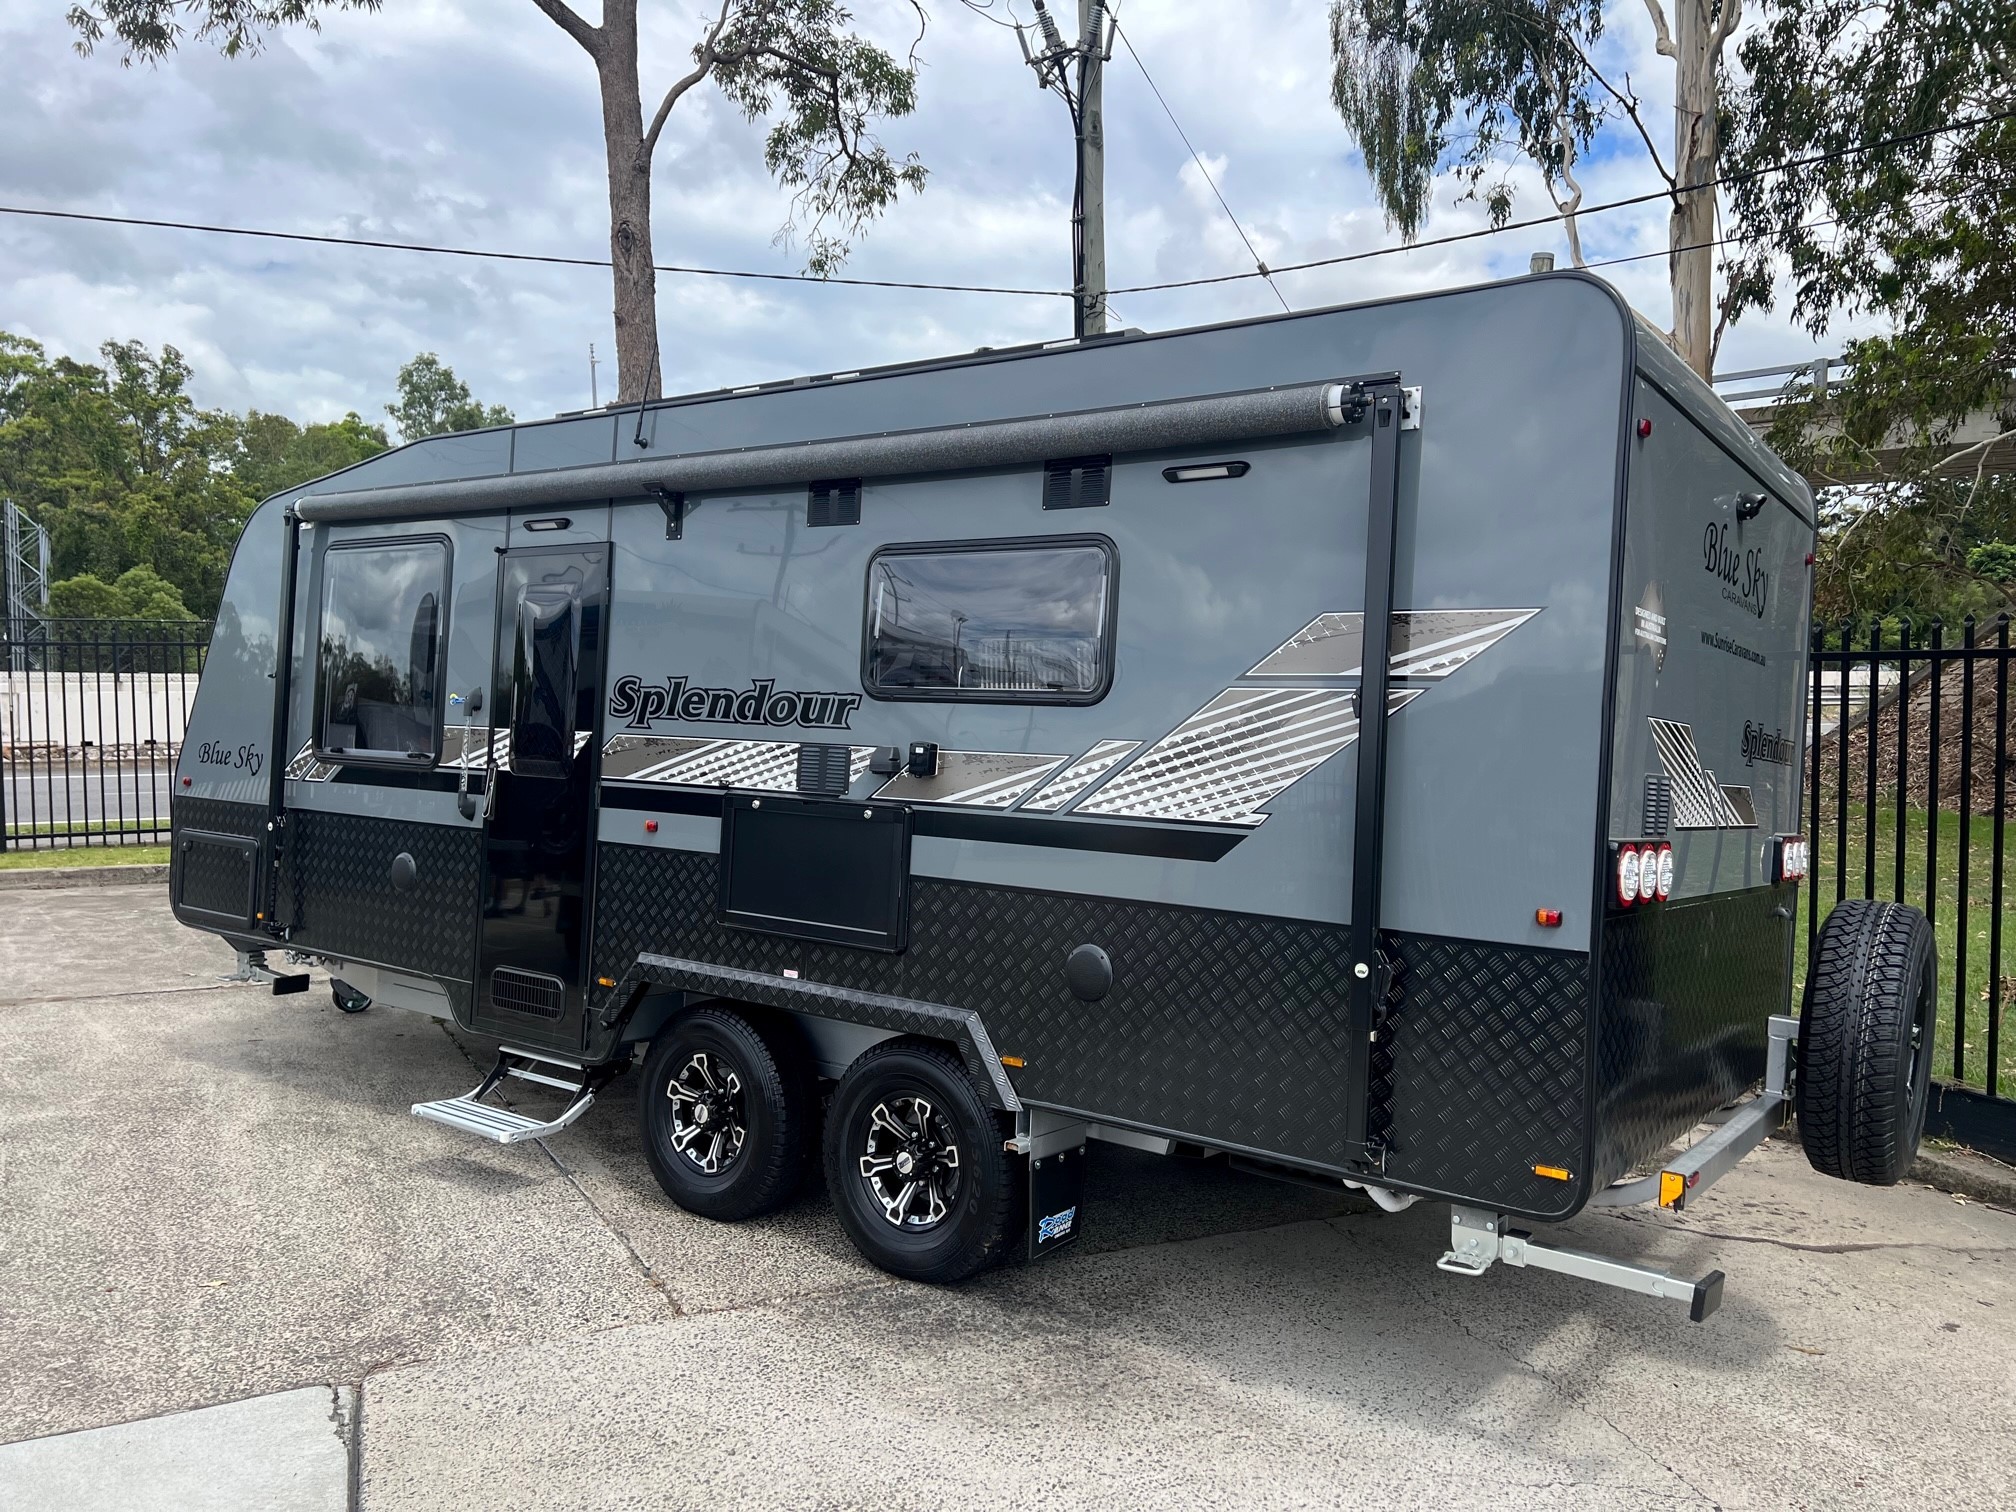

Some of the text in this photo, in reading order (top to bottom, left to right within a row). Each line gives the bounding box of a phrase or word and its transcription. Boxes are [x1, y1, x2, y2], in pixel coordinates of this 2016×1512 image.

[1703, 521, 1769, 619] Blue Sky
[1721, 587, 1758, 616] CARAVANS
[1700, 630, 1766, 667] www.SunriseCaravans.com.au
[609, 674, 863, 731] Splendour
[198, 740, 264, 776] Blue Sky
[1741, 719, 1795, 767] Splendour
